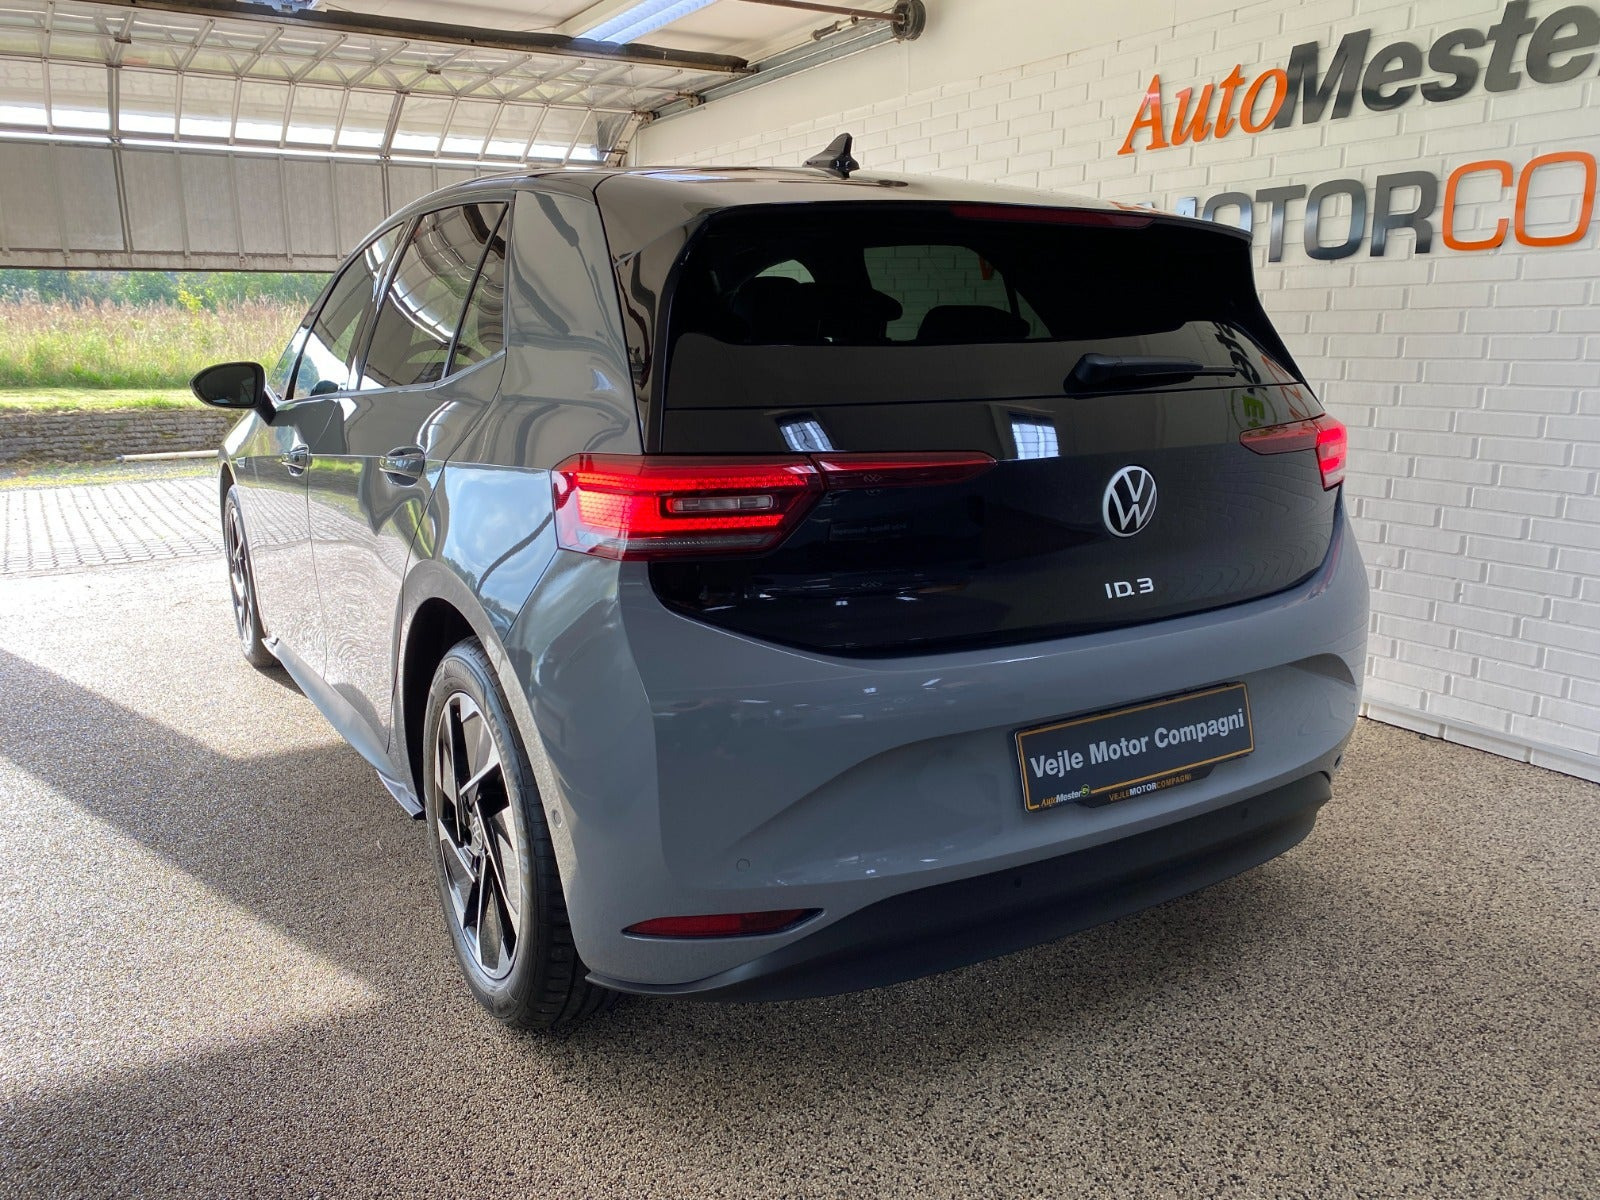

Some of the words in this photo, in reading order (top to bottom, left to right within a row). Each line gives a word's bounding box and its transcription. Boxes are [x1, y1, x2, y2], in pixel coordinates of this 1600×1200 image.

[1117, 0, 1600, 155] AutoMeste
[1175, 151, 1598, 263] OTORCO
[1030, 750, 1084, 778] Vejle
[1089, 735, 1149, 765] Motor
[1154, 708, 1245, 748] Compagni
[1108, 773, 1192, 801] VEJLEMOTORCOMPAGNI
